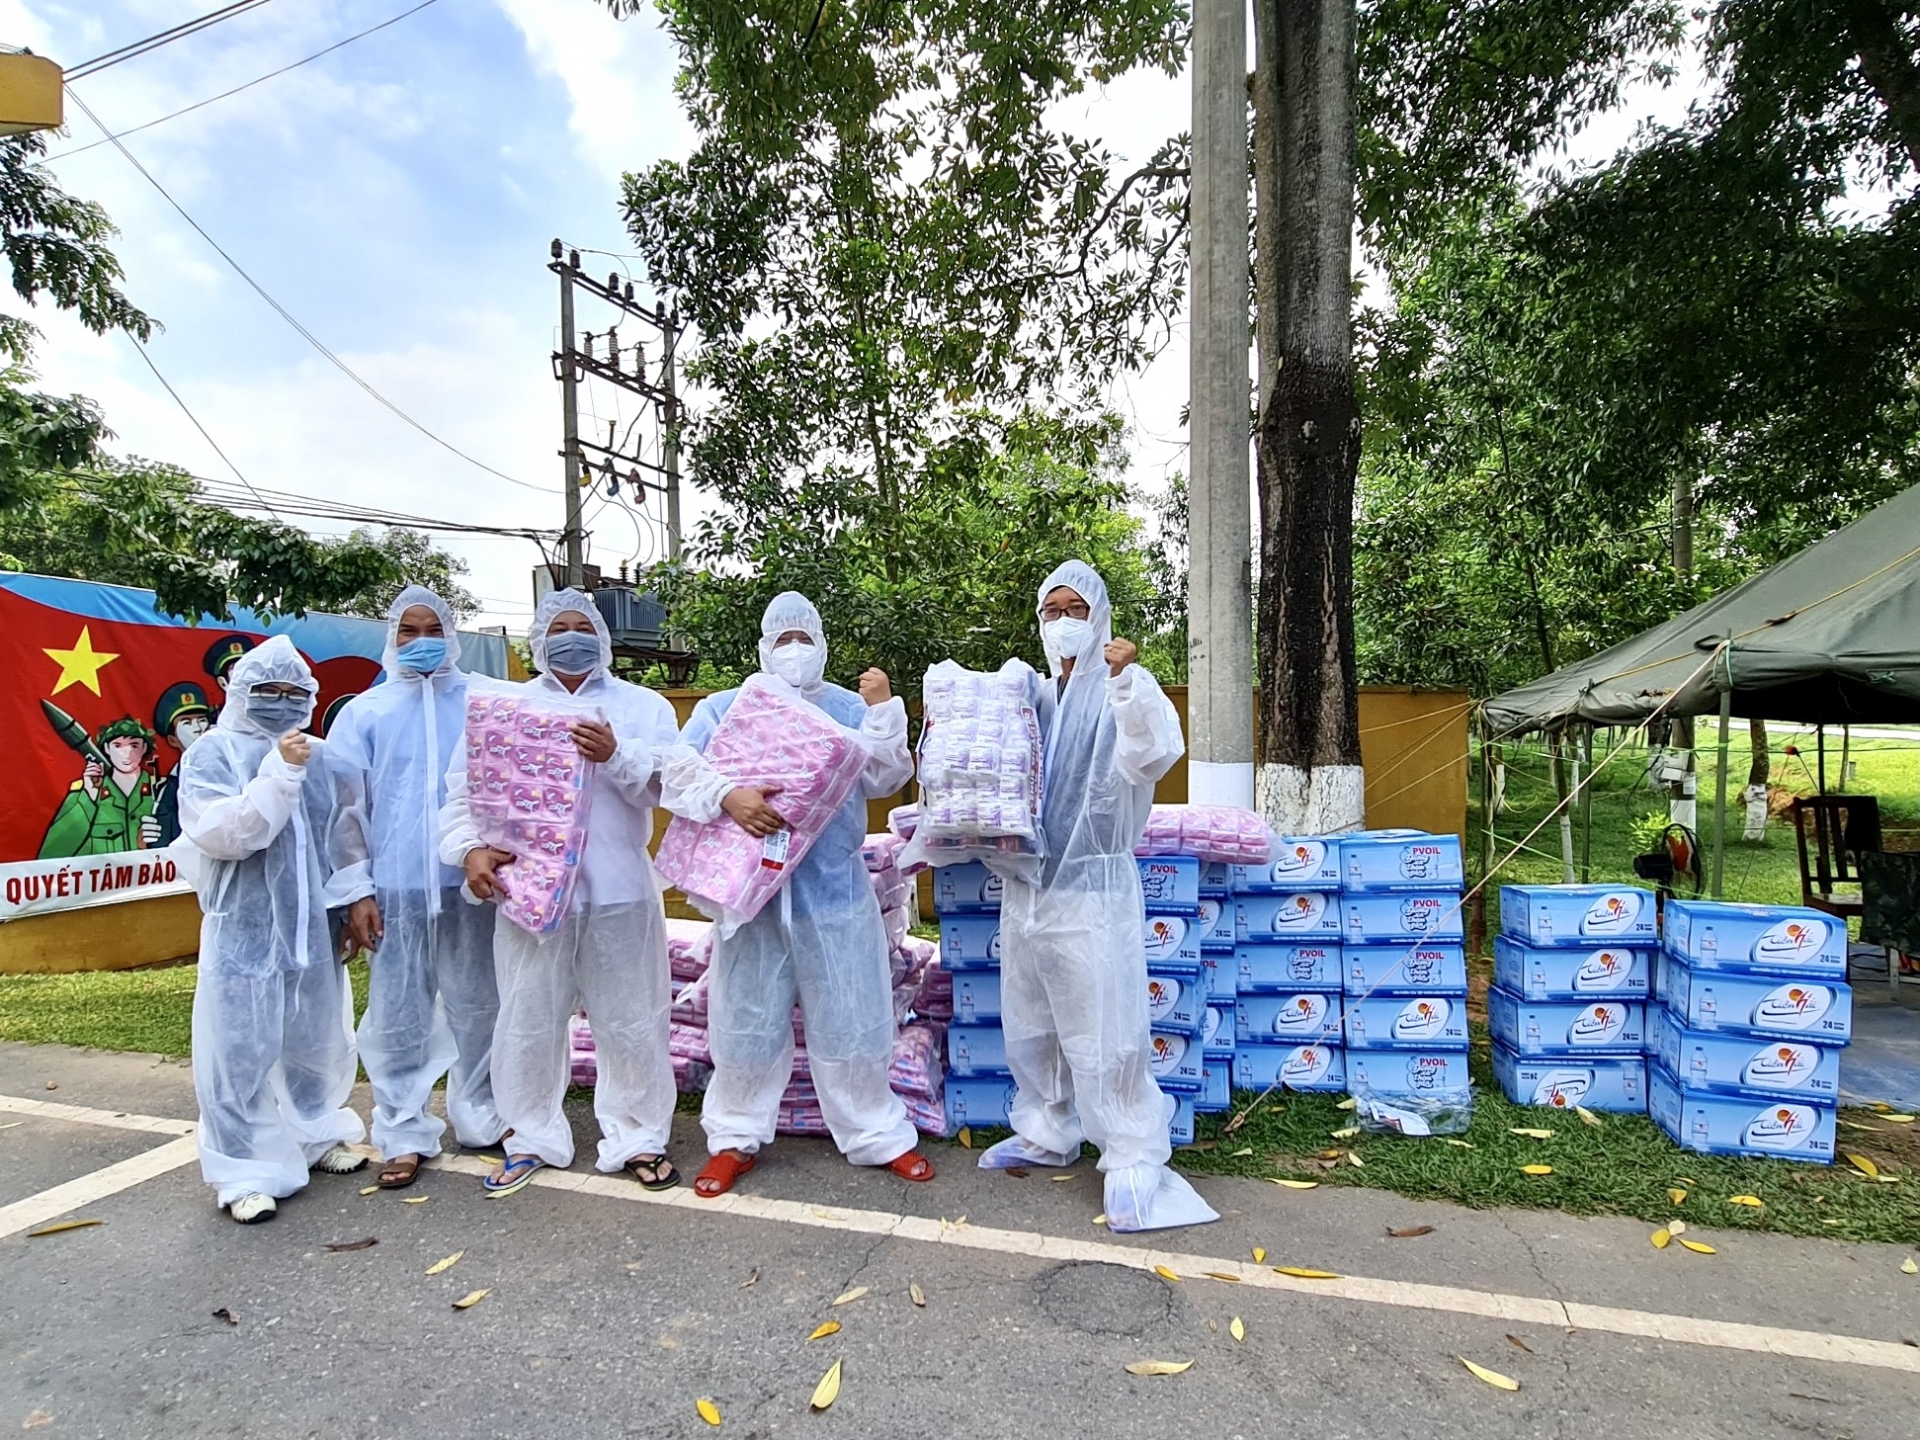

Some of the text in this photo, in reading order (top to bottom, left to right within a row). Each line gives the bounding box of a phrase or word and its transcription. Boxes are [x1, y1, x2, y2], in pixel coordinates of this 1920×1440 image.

[1412, 847, 1441, 855] PVOIL
[1150, 865, 1178, 874] PVOIL
[1321, 870, 1329, 878] 24
[6, 855, 177, 905] QUYẾT TÂM BẢO
[1208, 877, 1216, 885] 24
[1413, 899, 1442, 907] PVOIL
[1180, 950, 1188, 958] 24
[1299, 949, 1325, 957] PVOIL
[1415, 951, 1444, 959] PVOIL
[1820, 954, 1829, 963] 24
[1200, 960, 1217, 968] OIL
[1628, 979, 1636, 987] 24
[1174, 1012, 1182, 1020] 24
[1823, 1020, 1832, 1029] 24
[1446, 1028, 1453, 1036] 24
[1622, 1033, 1630, 1041] 24
[1215, 1038, 1223, 1046] 24
[1419, 1058, 1448, 1066] PVOIL
[1180, 1067, 1188, 1075] 24
[1327, 1074, 1335, 1082] 24
[1811, 1079, 1820, 1088] 24
[1171, 1127, 1178, 1135] 24
[1809, 1140, 1818, 1149] 24
